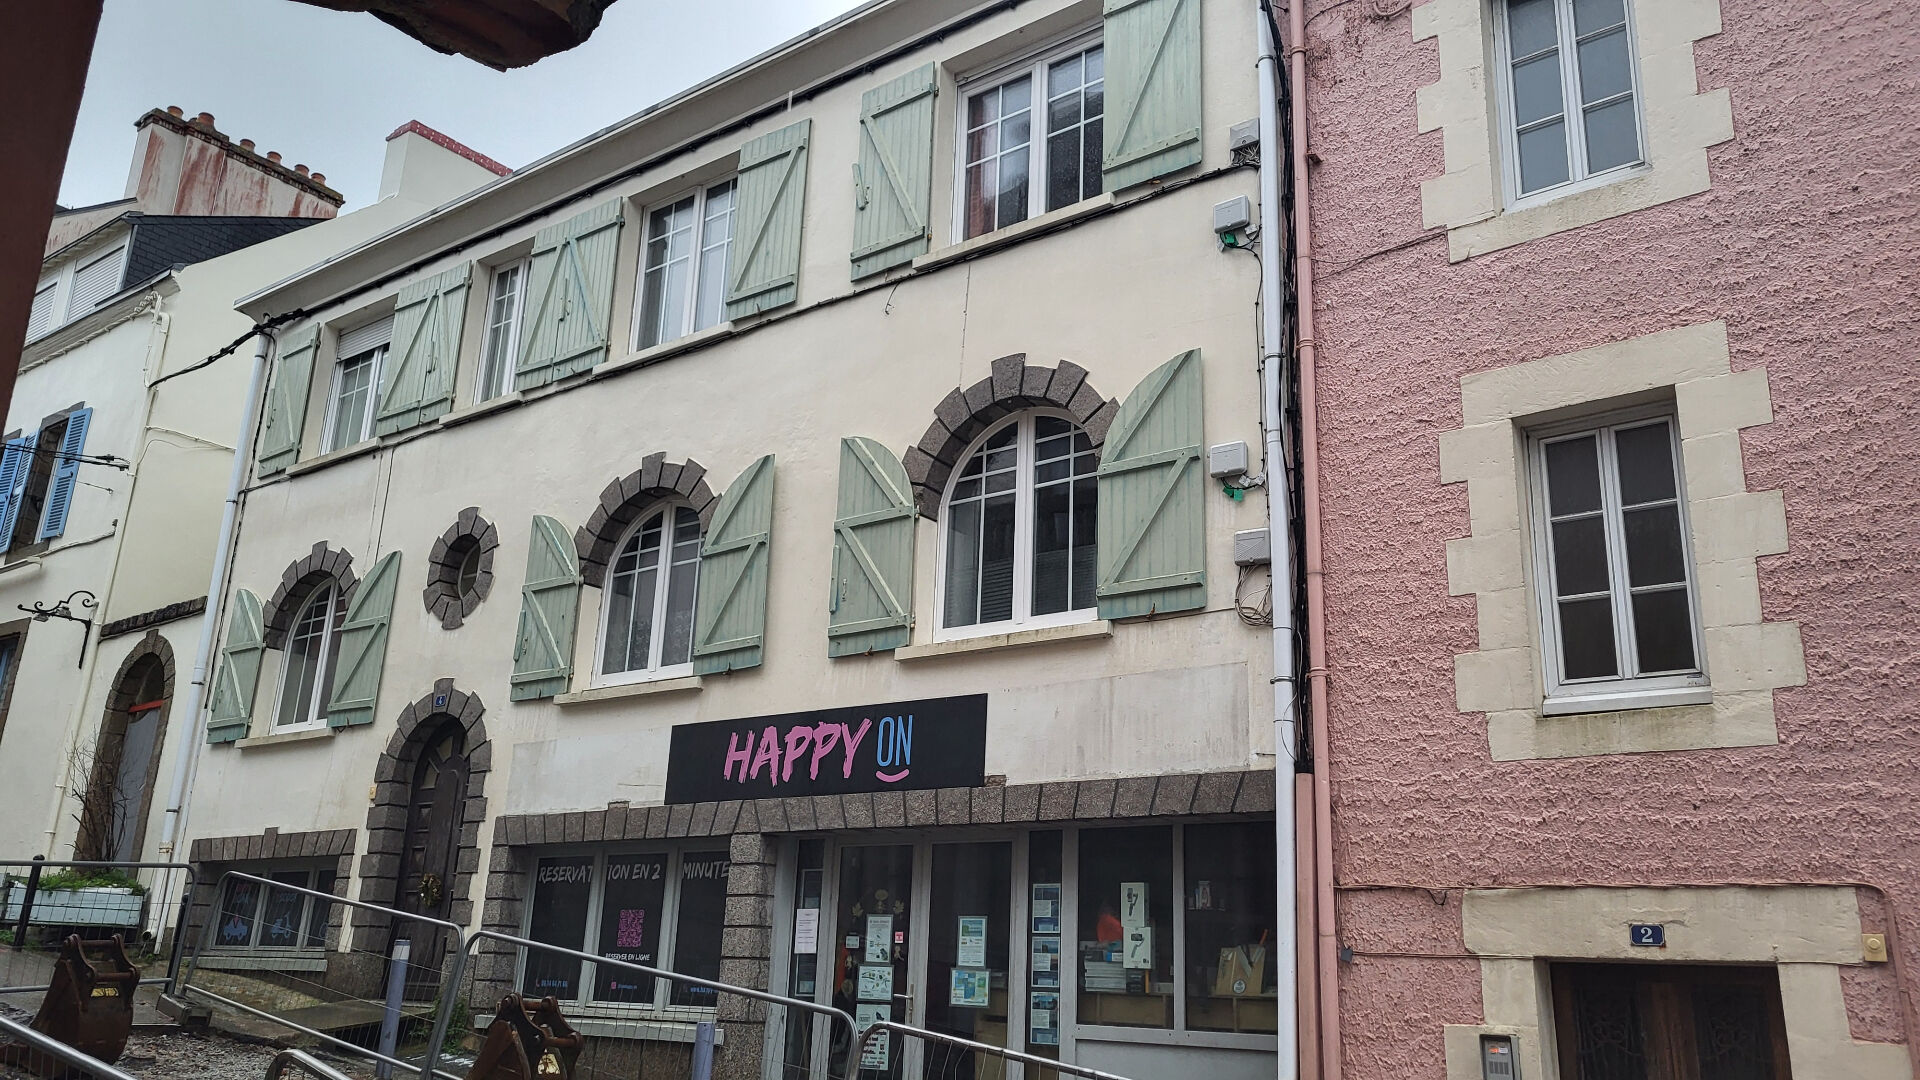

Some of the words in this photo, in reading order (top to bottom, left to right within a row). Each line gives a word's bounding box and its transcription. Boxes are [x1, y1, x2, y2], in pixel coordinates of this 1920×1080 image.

[723, 717, 873, 787] HAPPY
[876, 714, 914, 767] ON
[632, 863, 650, 880] EN
[652, 863, 662, 880] 2
[1640, 926, 1654, 943] 2
[628, 953, 635, 961] EN
[635, 953, 651, 962] LIGNE
